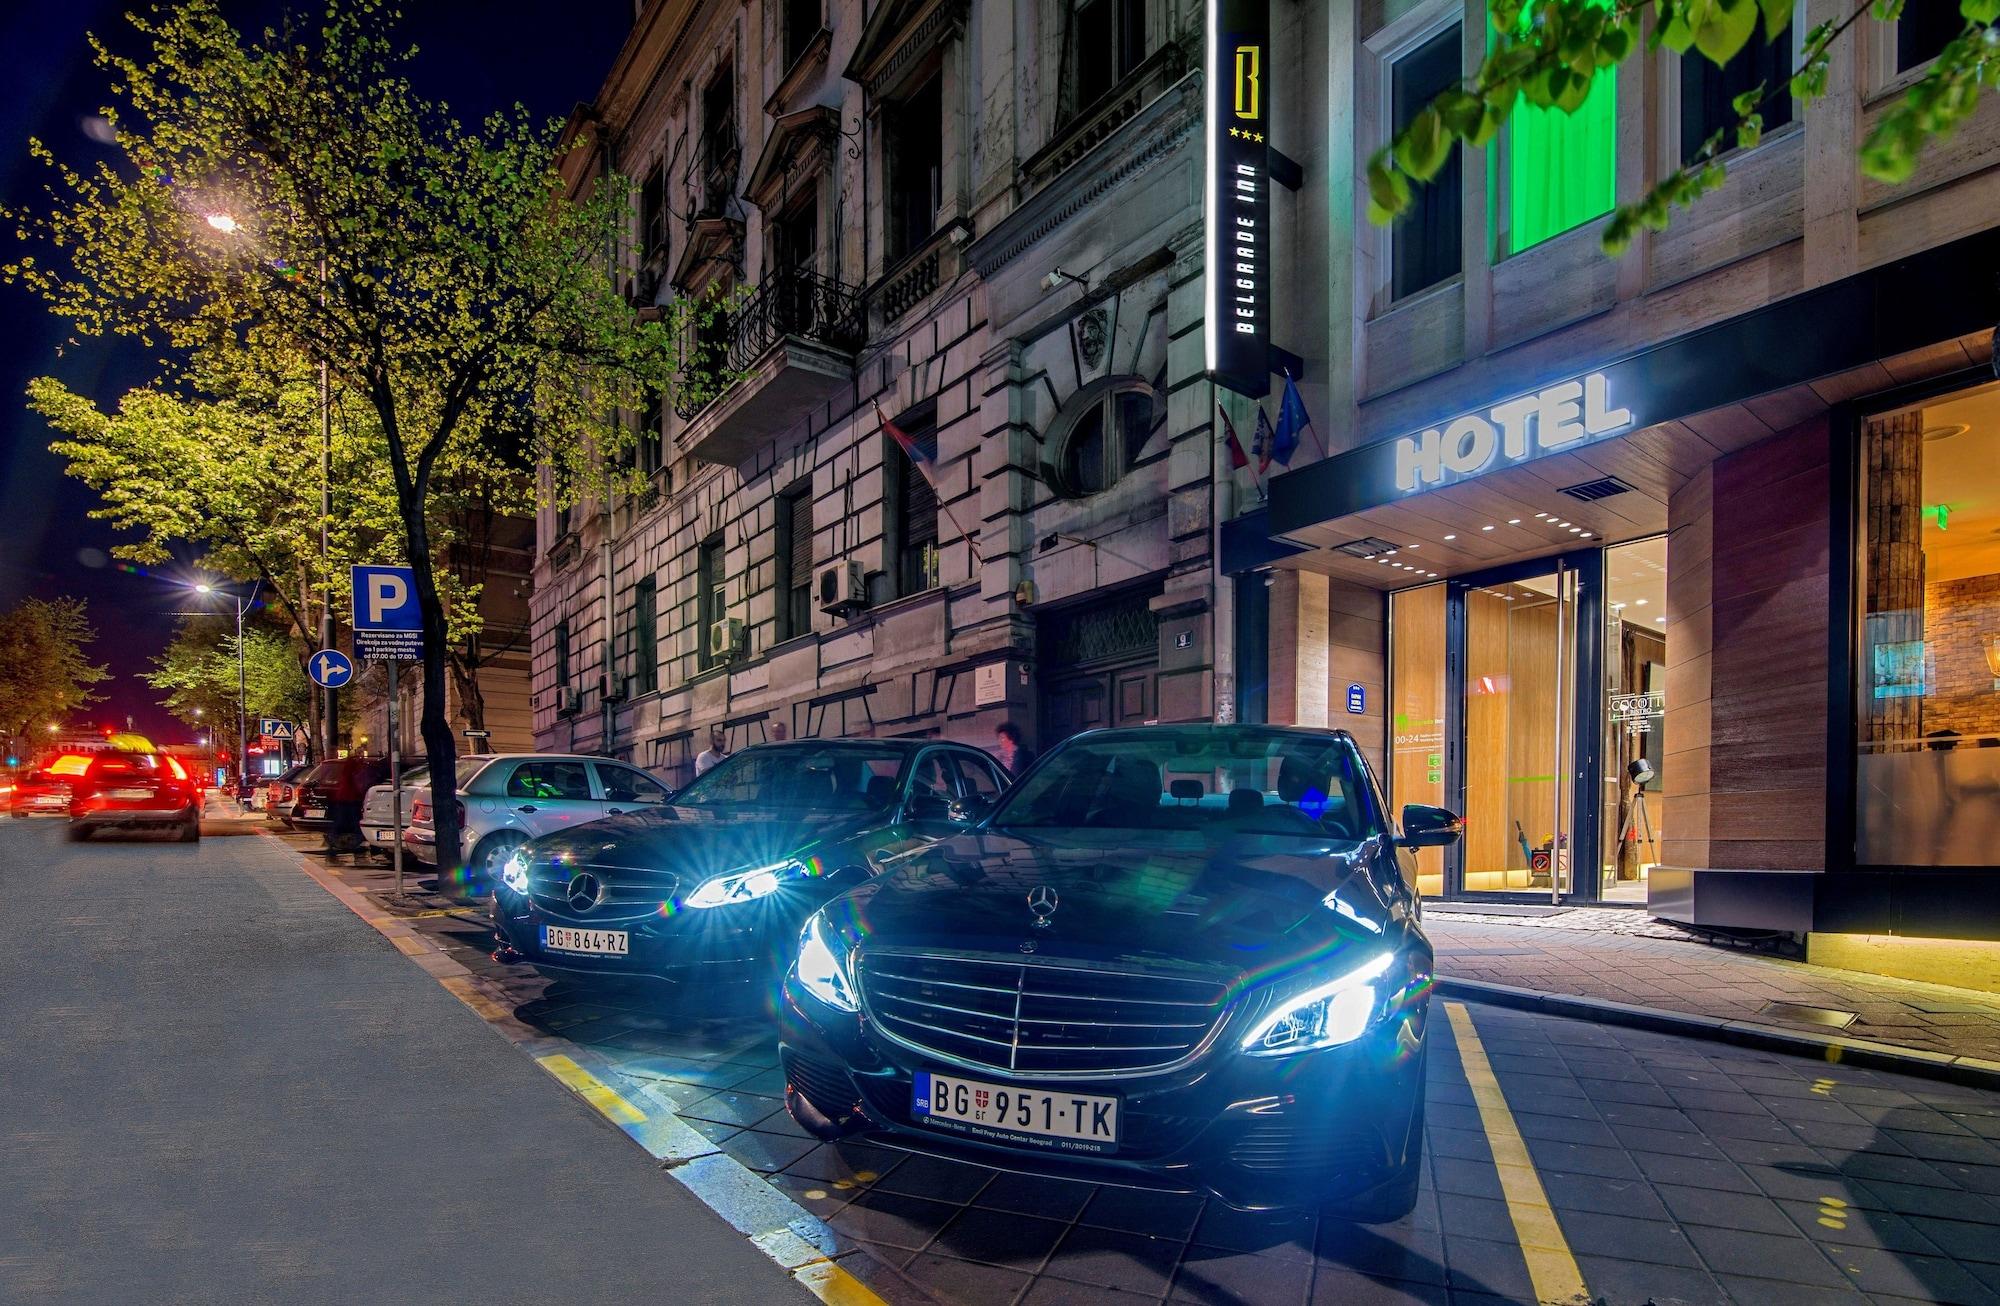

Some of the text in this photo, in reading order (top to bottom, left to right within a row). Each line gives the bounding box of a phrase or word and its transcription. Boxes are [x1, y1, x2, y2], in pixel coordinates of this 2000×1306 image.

[1236, 163, 1256, 335] BELGRADE INN
[1395, 373, 1631, 491] HOTEL
[368, 573, 408, 623] P
[549, 929, 563, 946] BG
[916, 1097, 929, 1108] SRB
[935, 1081, 969, 1116] BG
[1029, 1138, 1053, 1146] Beograd
